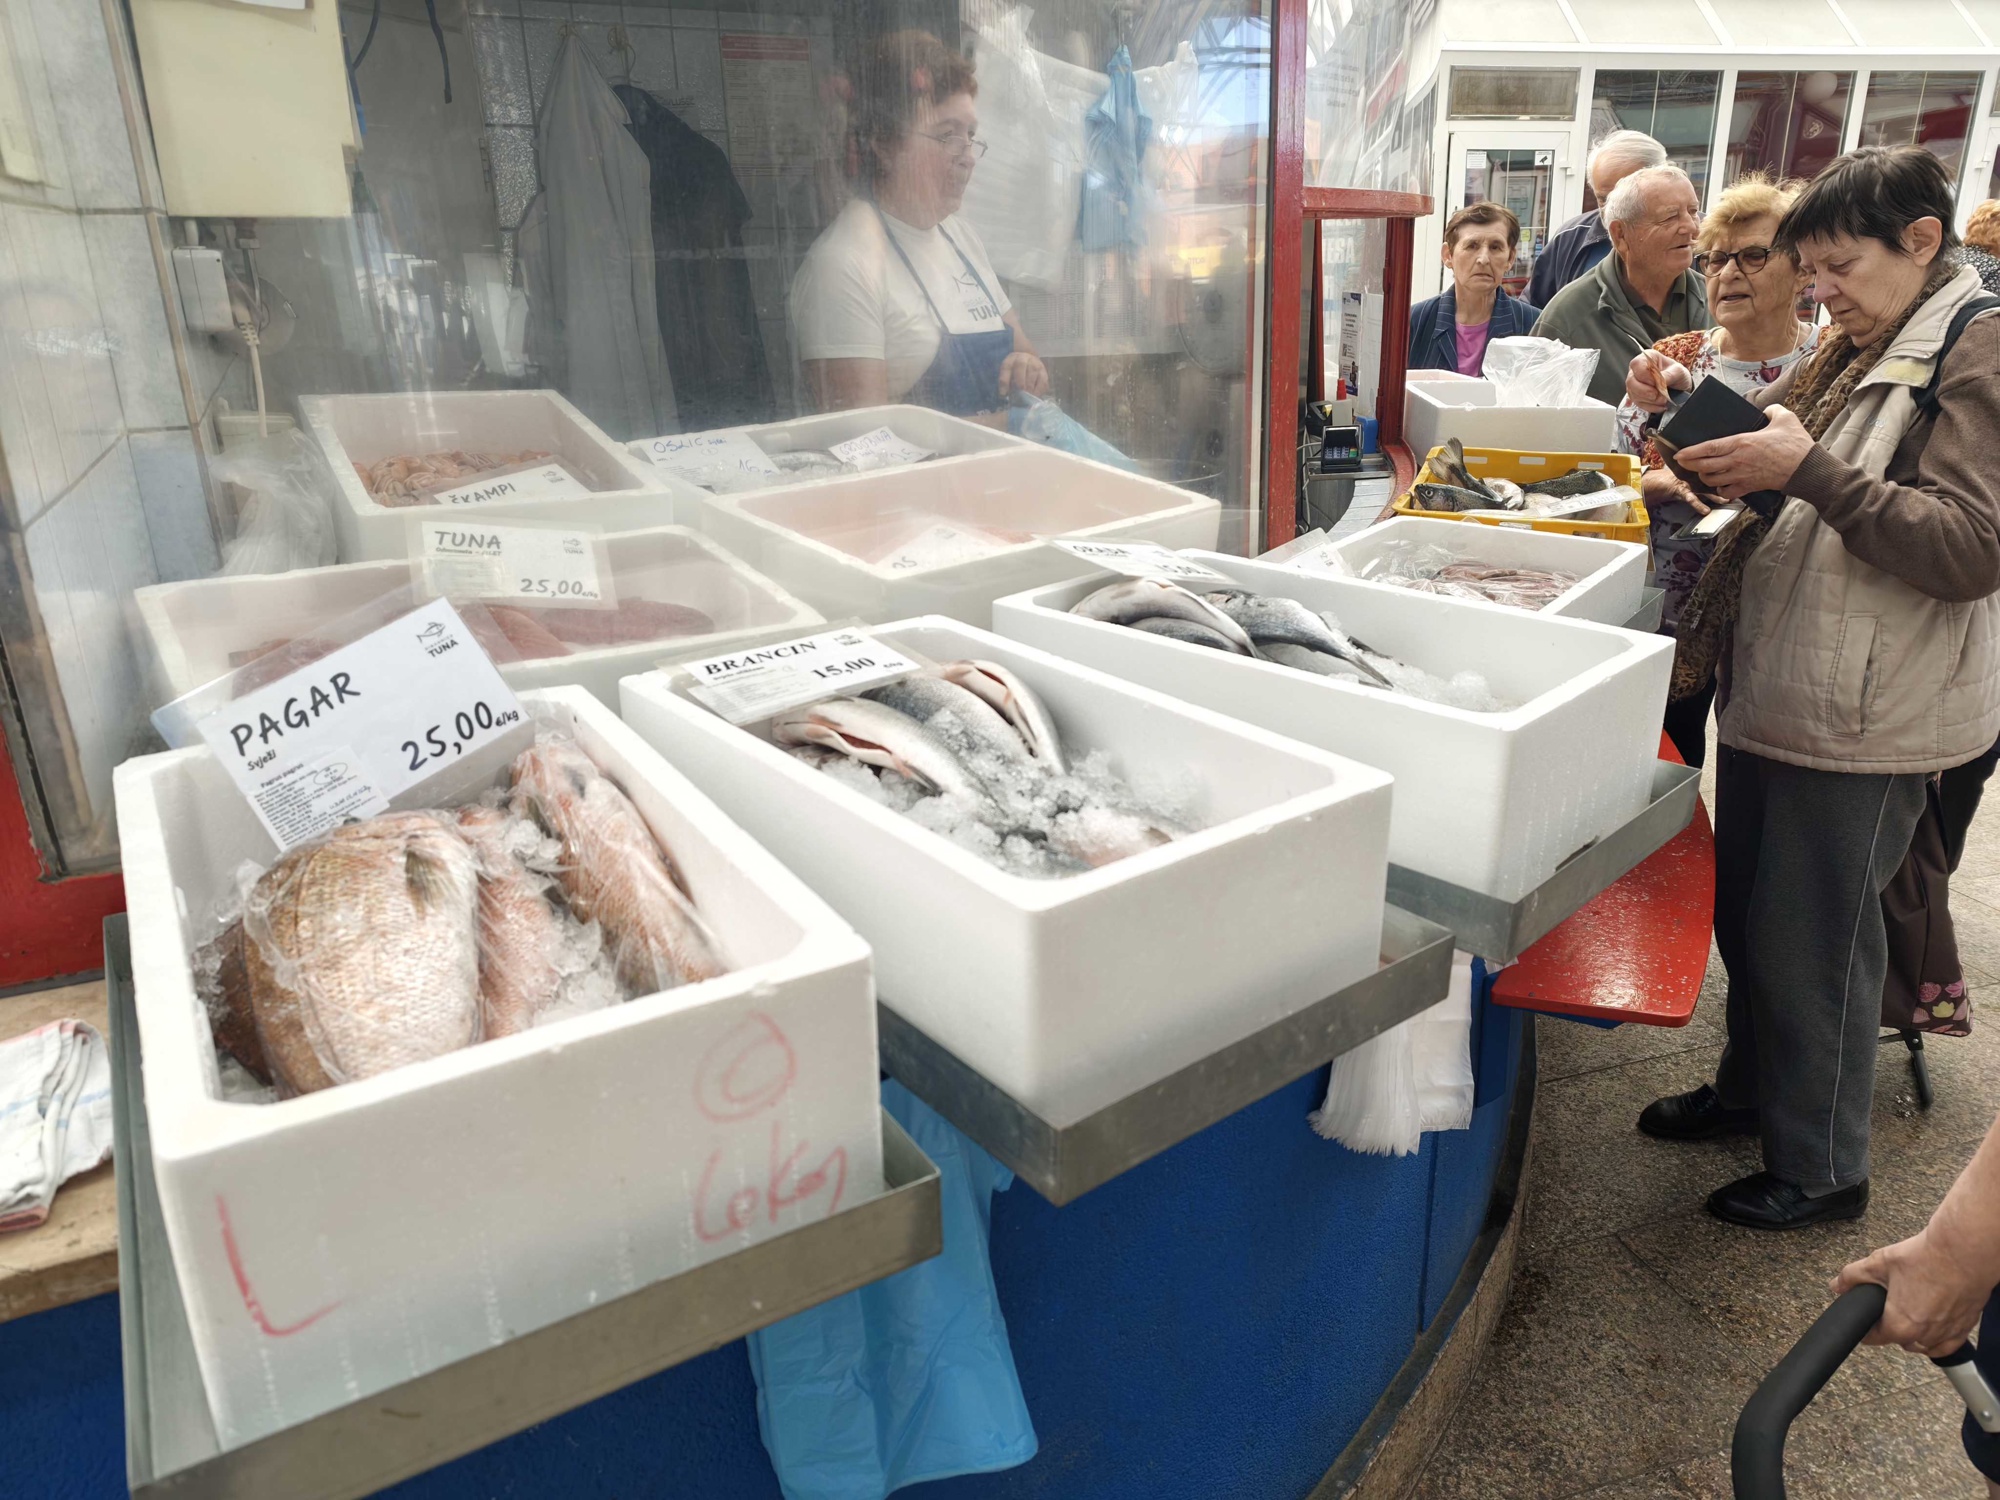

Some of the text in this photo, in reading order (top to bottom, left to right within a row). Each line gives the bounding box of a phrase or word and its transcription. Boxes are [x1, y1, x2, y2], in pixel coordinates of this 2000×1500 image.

[434, 530, 502, 550] TUNA
[427, 638, 459, 659] TUNA
[703, 640, 818, 676] BRANCIN
[229, 671, 362, 757] PAGAR
